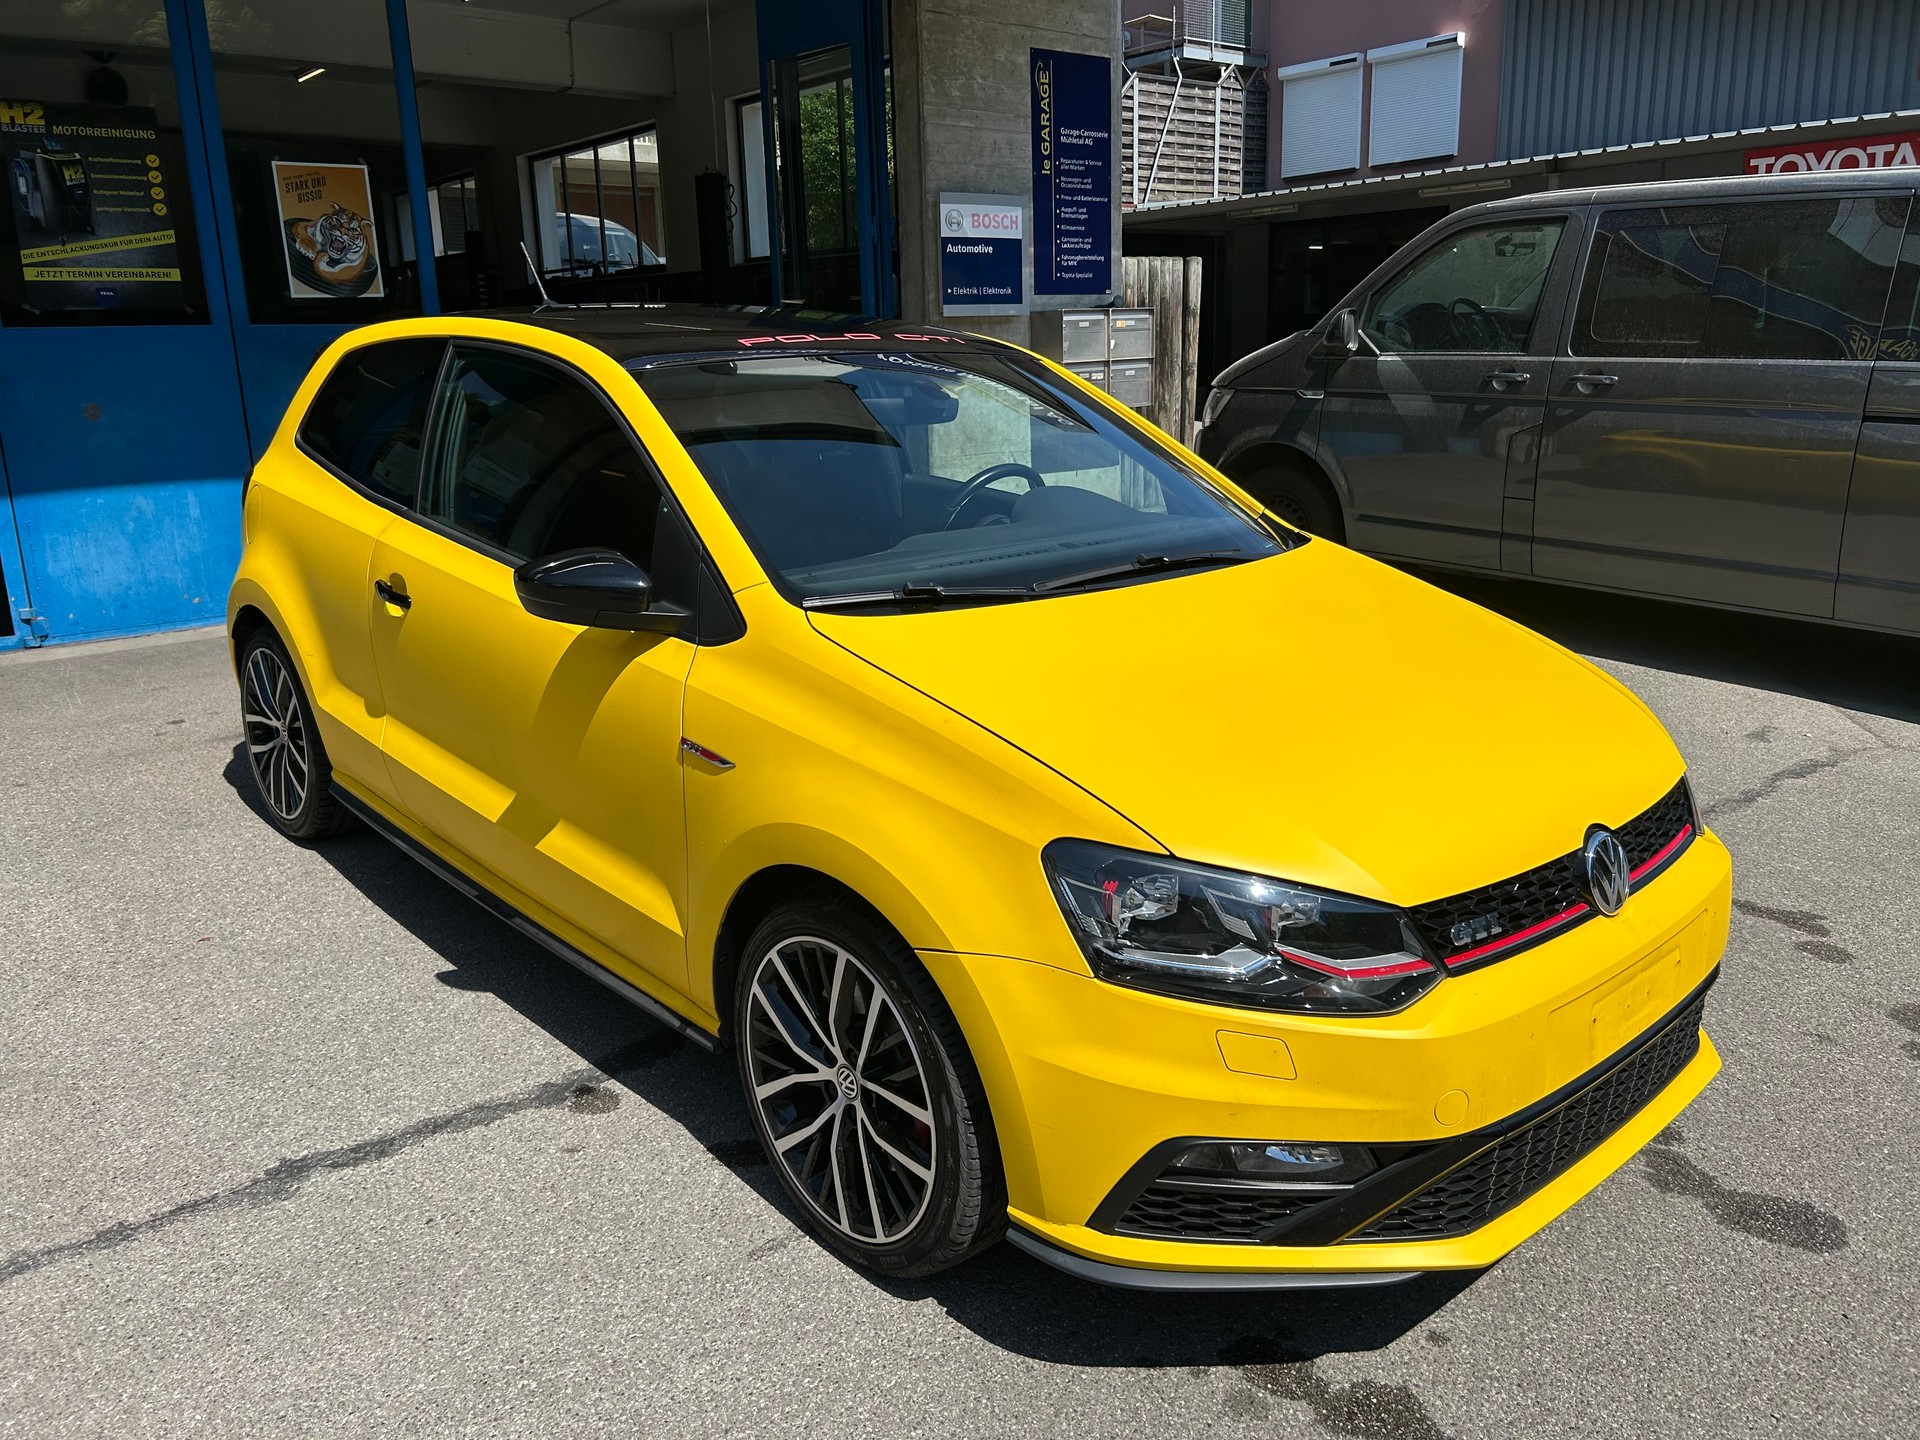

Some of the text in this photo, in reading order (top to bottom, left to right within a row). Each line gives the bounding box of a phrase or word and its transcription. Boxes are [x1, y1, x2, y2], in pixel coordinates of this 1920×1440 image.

[0, 101, 46, 125] H2
[1040, 70, 1051, 156] GARAGE
[1, 124, 46, 134] BLASTER
[52, 125, 156, 140] MOTORREINIGUNG
[1084, 138, 1094, 146] AG
[285, 179, 310, 194] STARK
[311, 176, 327, 189] UND
[297, 189, 323, 204] BISSIG
[971, 213, 1019, 230] BOSCH
[22, 233, 174, 260] DIE ENTSCHLACKUNGSKUR FÜR DEIN AUTO!
[946, 244, 993, 254] Automotive
[34, 270, 172, 279] JETZT TERMIN VEREINBAREN!
[953, 287, 1012, 295] Elektrik Elektronik
[737, 332, 882, 347] POLO
